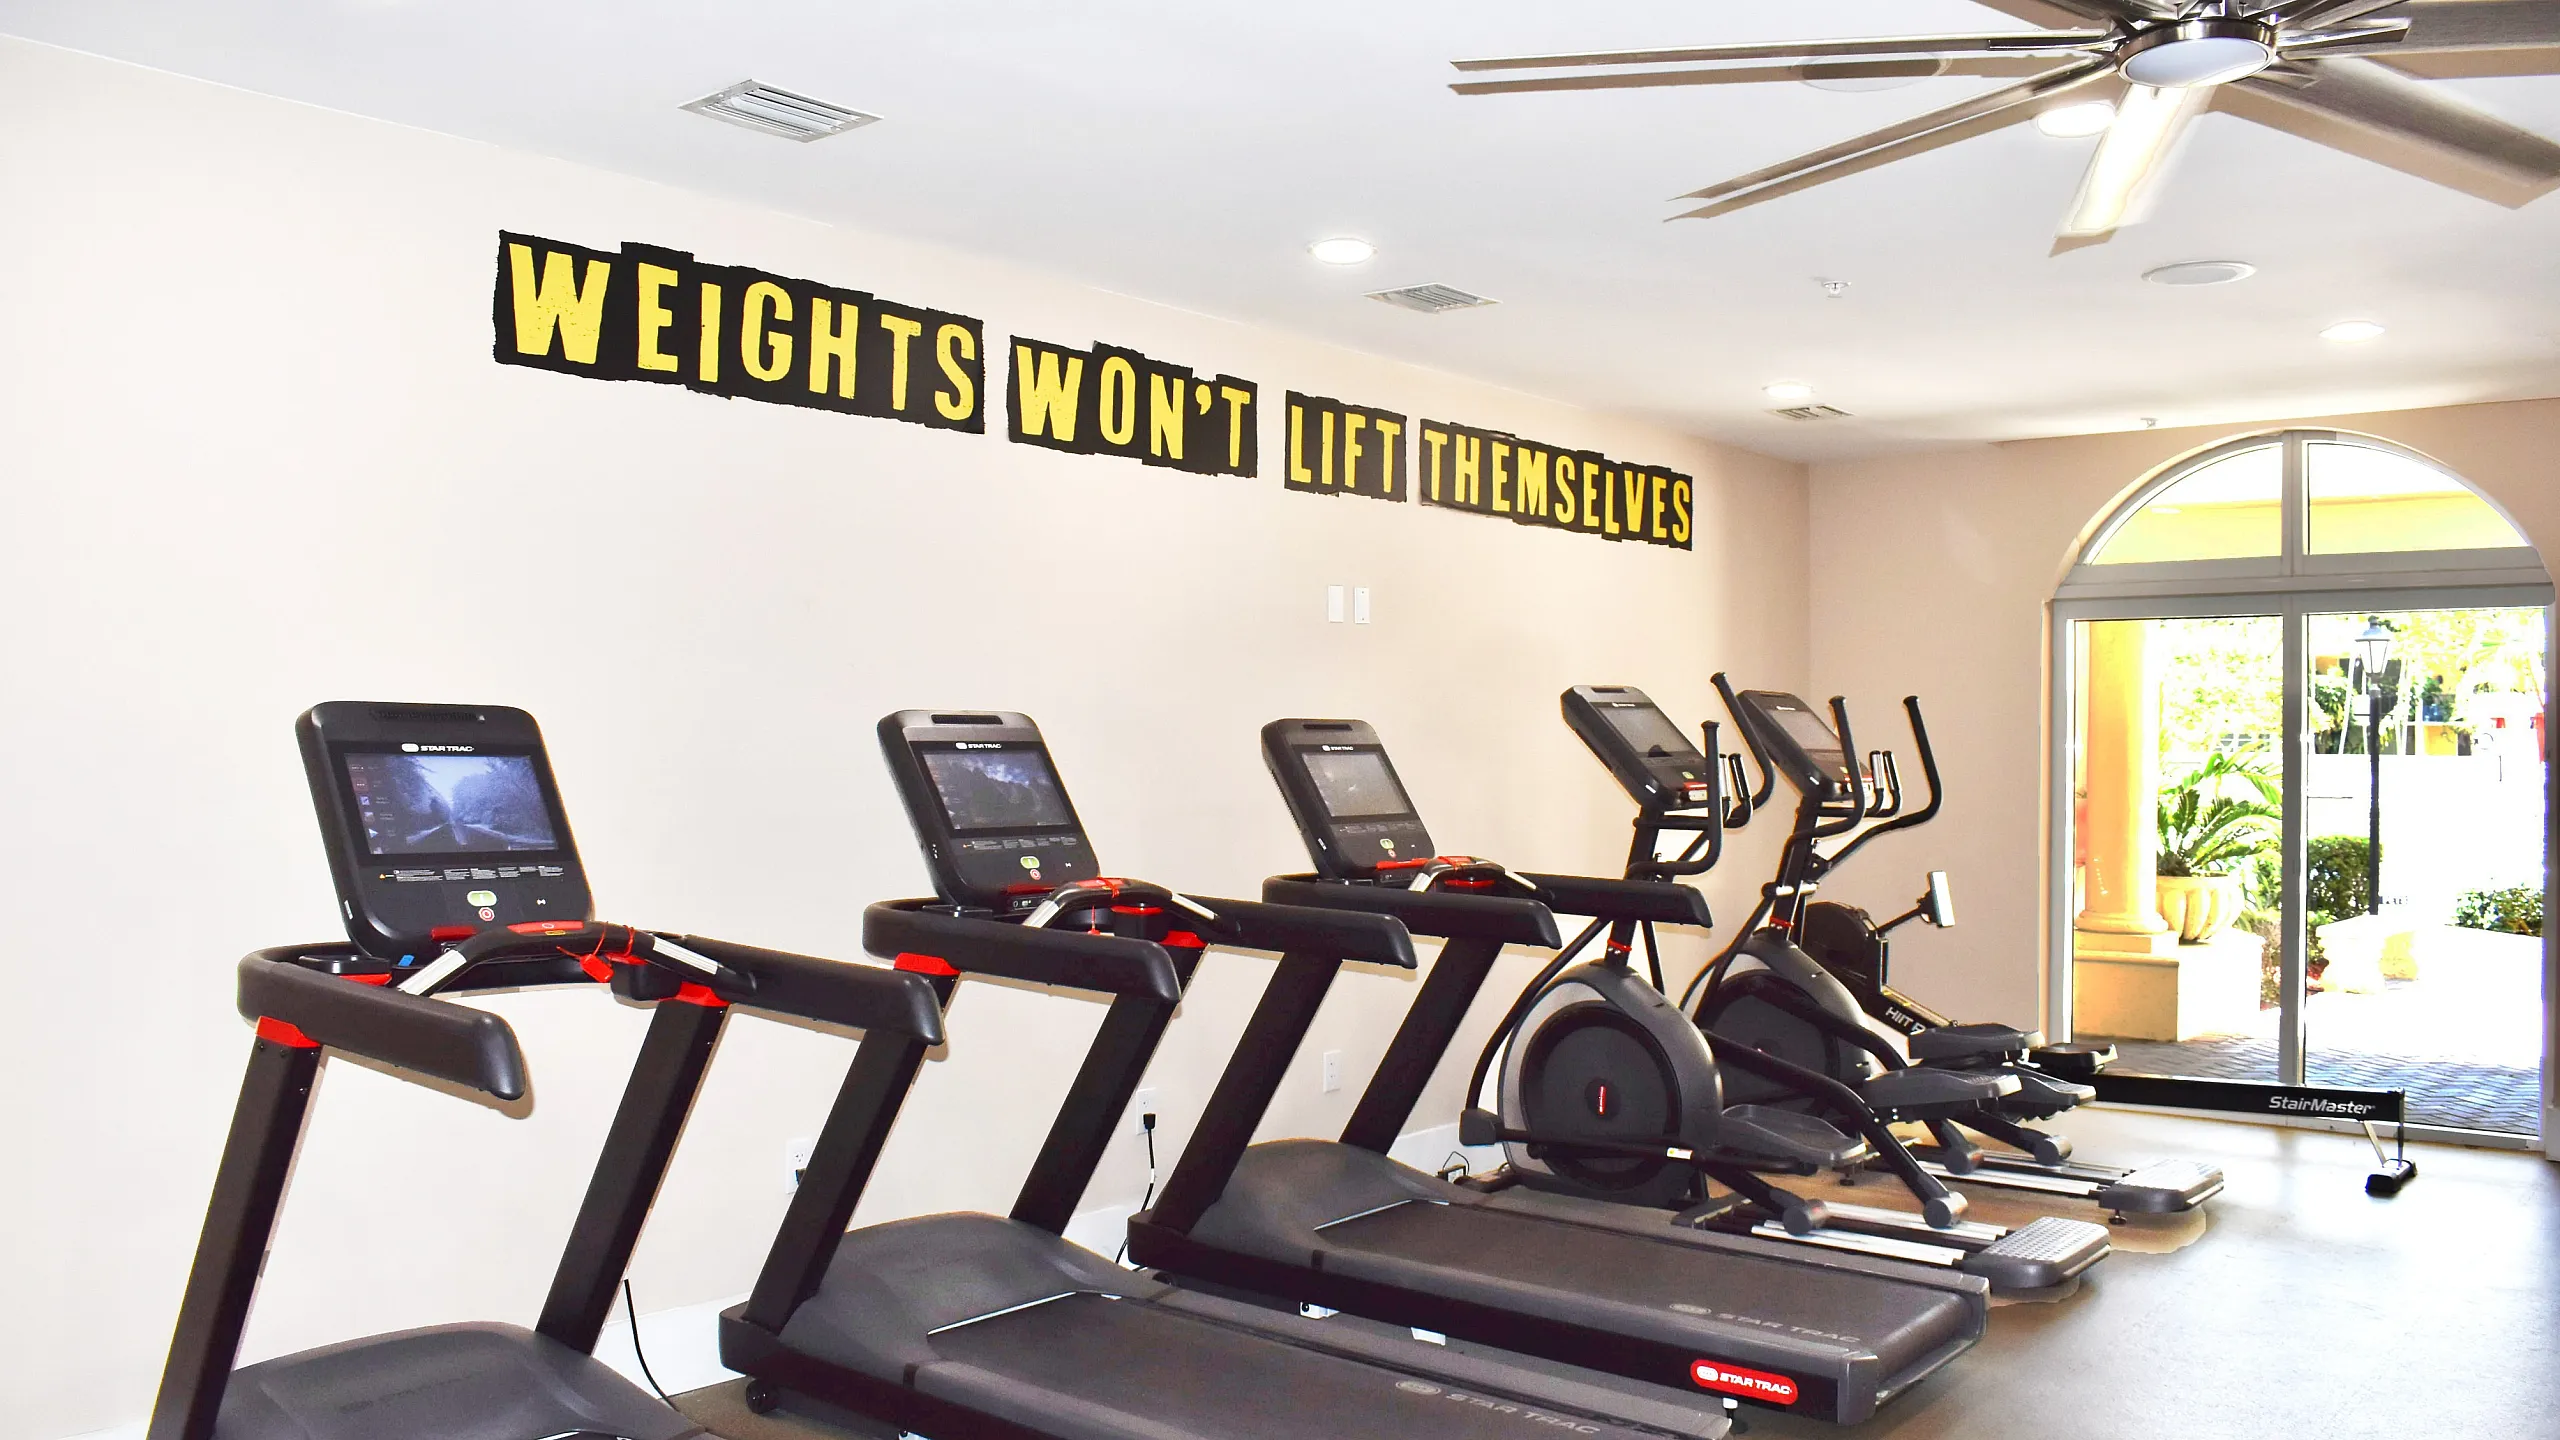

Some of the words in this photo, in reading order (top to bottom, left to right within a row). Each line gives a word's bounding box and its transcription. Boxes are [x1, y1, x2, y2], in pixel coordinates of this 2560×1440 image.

[509, 243, 975, 420] WEIGHTS
[1016, 346, 1251, 467] WON'T
[1290, 405, 1401, 492] LIFT
[1424, 429, 1690, 542] THEMSELVES
[1885, 1006, 1914, 1027] HIIT
[2268, 1095, 2372, 1115] StairMaster
[1716, 1312, 1784, 1329] STAR
[1789, 1325, 1861, 1344] TRAC
[1719, 1372, 1754, 1388] STAR
[1755, 1379, 1791, 1395] TRAC
[1446, 1393, 1518, 1414] STAR
[1523, 1411, 1601, 1434] TRAC
